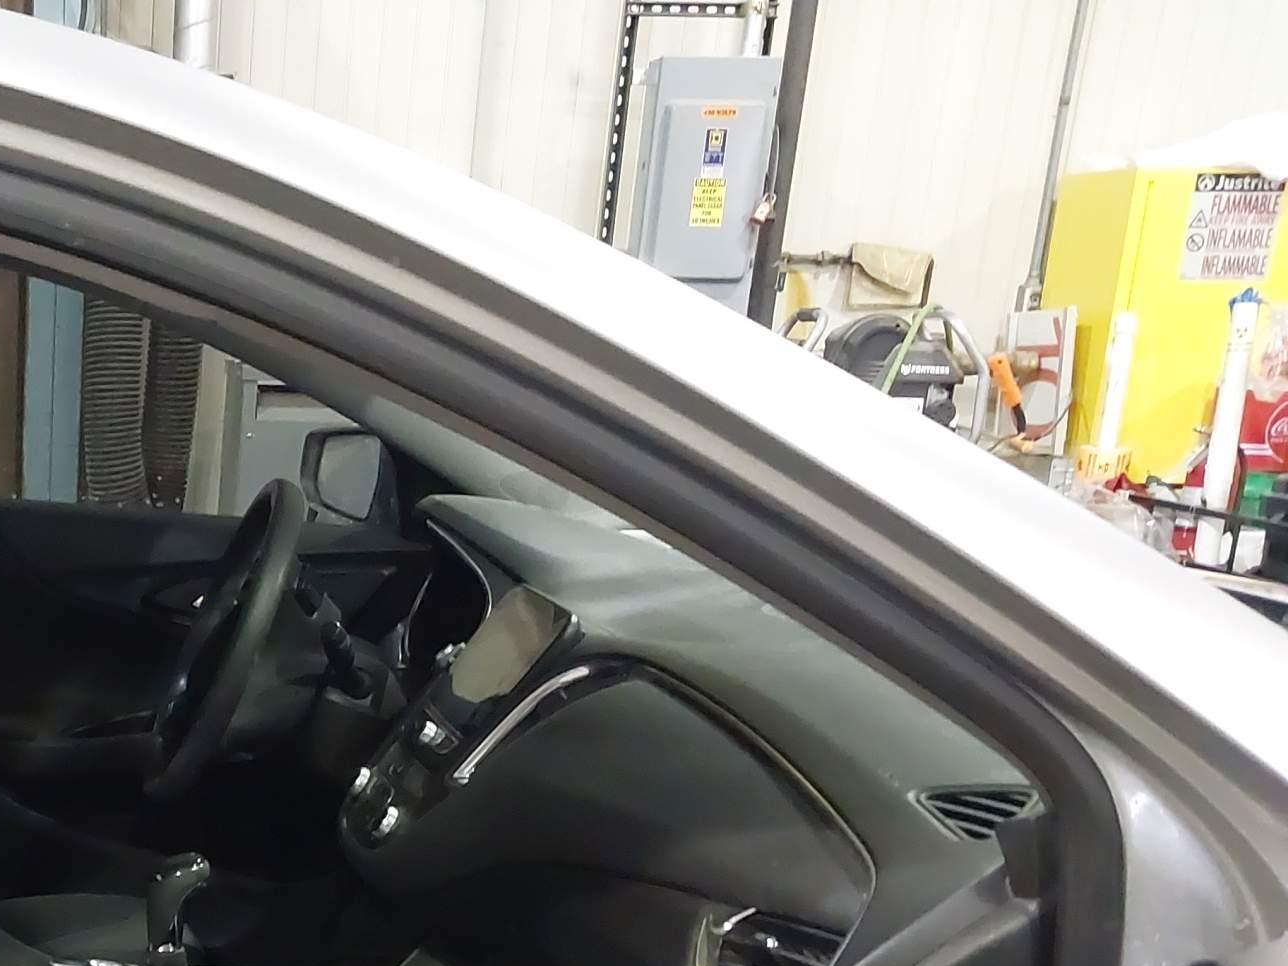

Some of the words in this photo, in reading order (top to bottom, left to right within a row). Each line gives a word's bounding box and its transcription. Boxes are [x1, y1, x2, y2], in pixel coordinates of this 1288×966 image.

[1211, 194, 1282, 215] FLAMMABLE
[1206, 228, 1273, 249] INFLAMABLE
[1200, 255, 1267, 276] INFLAMMABLE
[911, 364, 950, 375] FORTRESS
